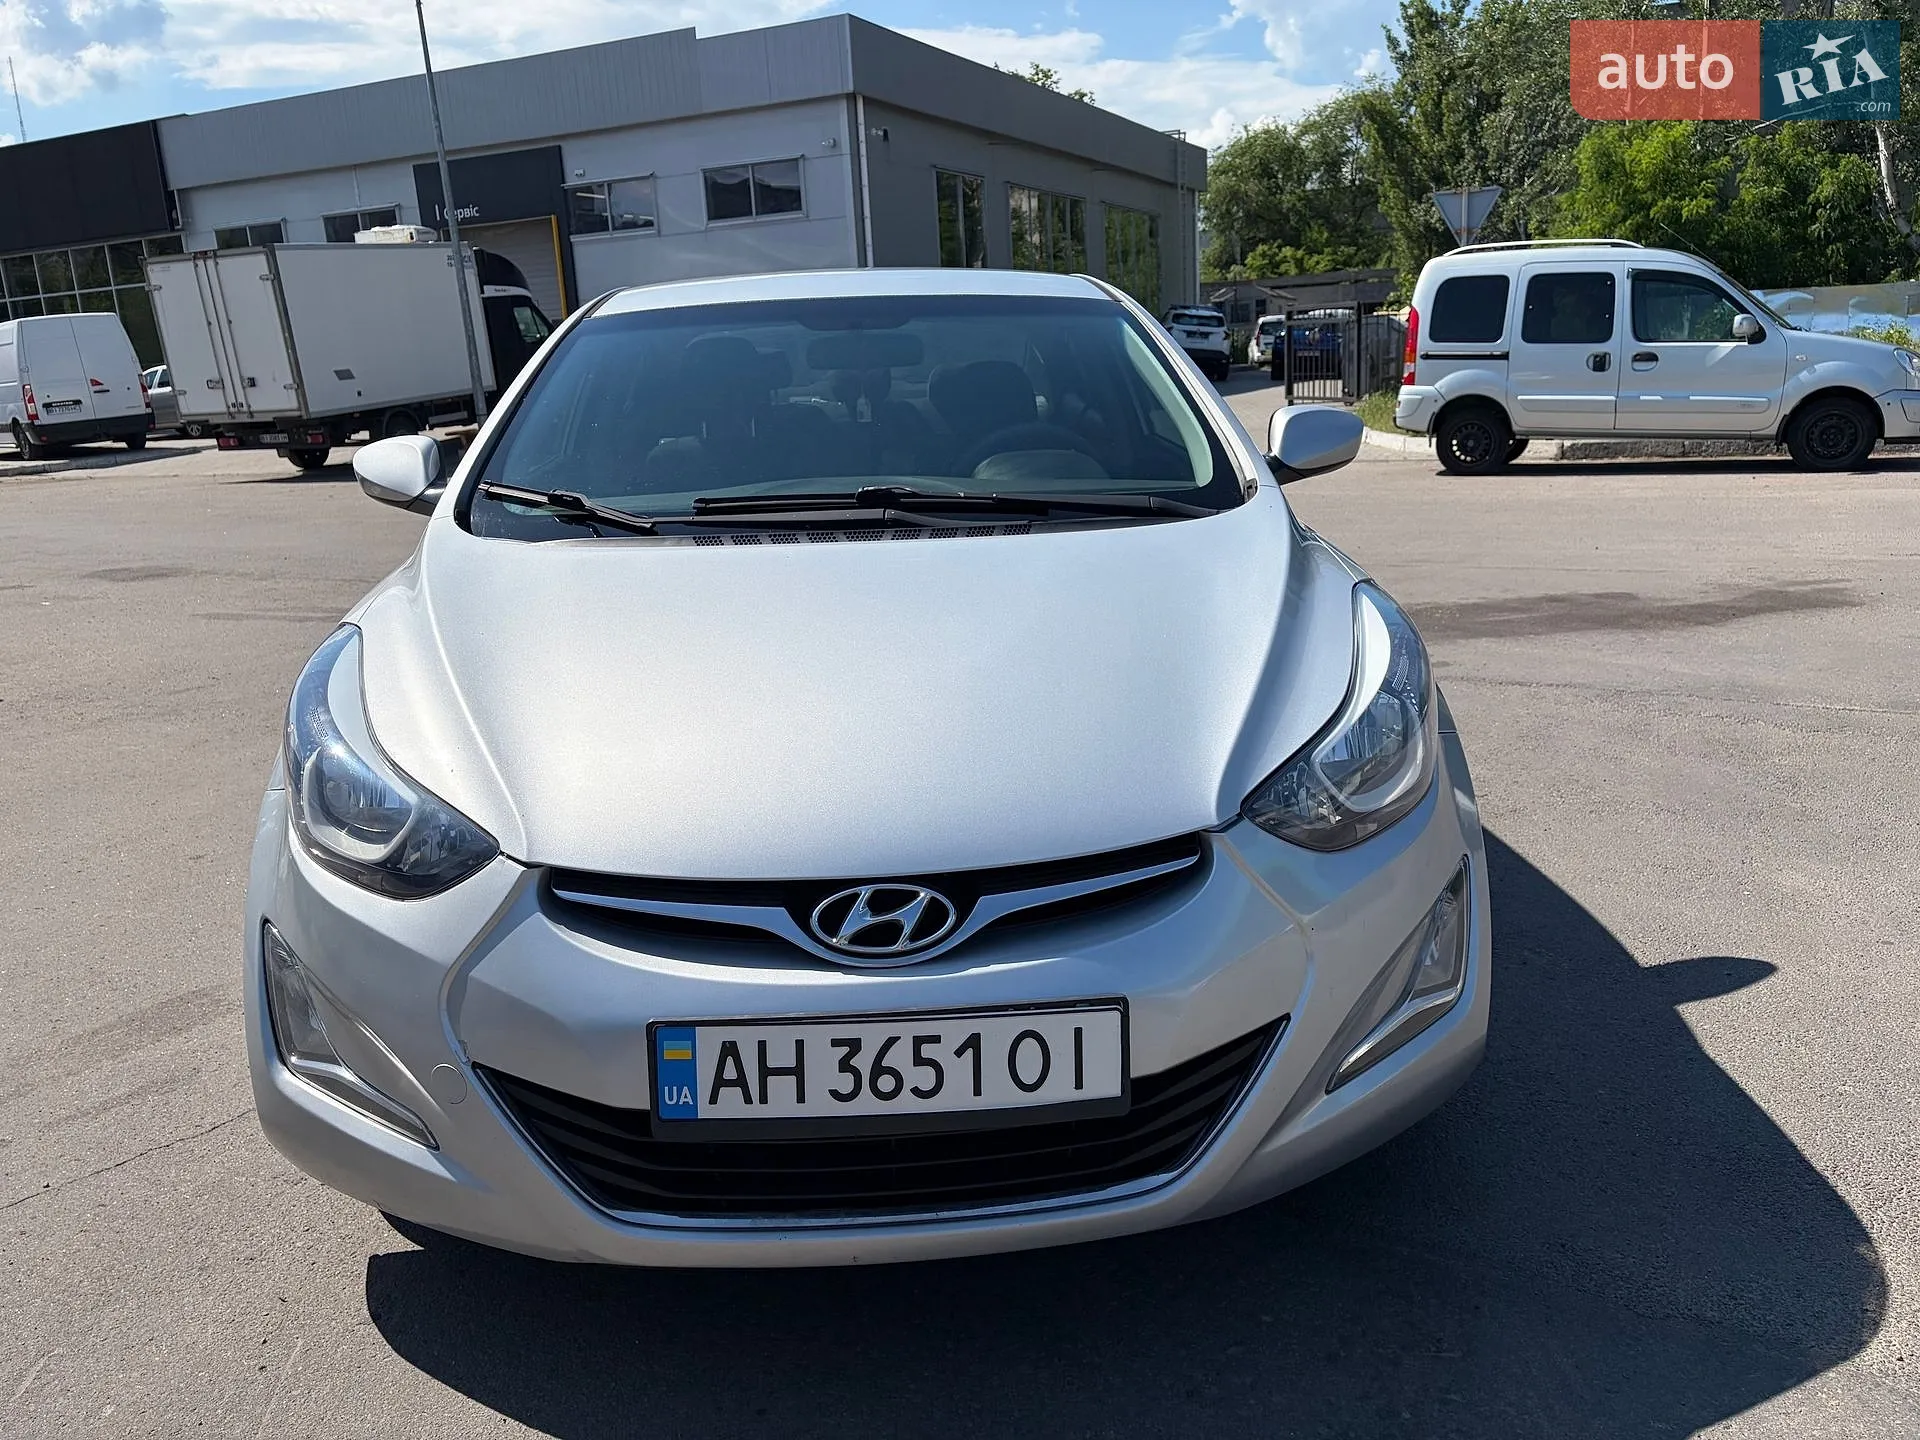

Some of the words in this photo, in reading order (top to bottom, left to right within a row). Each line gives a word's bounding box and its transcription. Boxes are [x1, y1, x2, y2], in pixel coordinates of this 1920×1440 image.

[708, 1039, 806, 1105] AH
[828, 1032, 982, 1103] 3651
[1007, 1027, 1084, 1093] OI
[664, 1086, 694, 1105] UA
